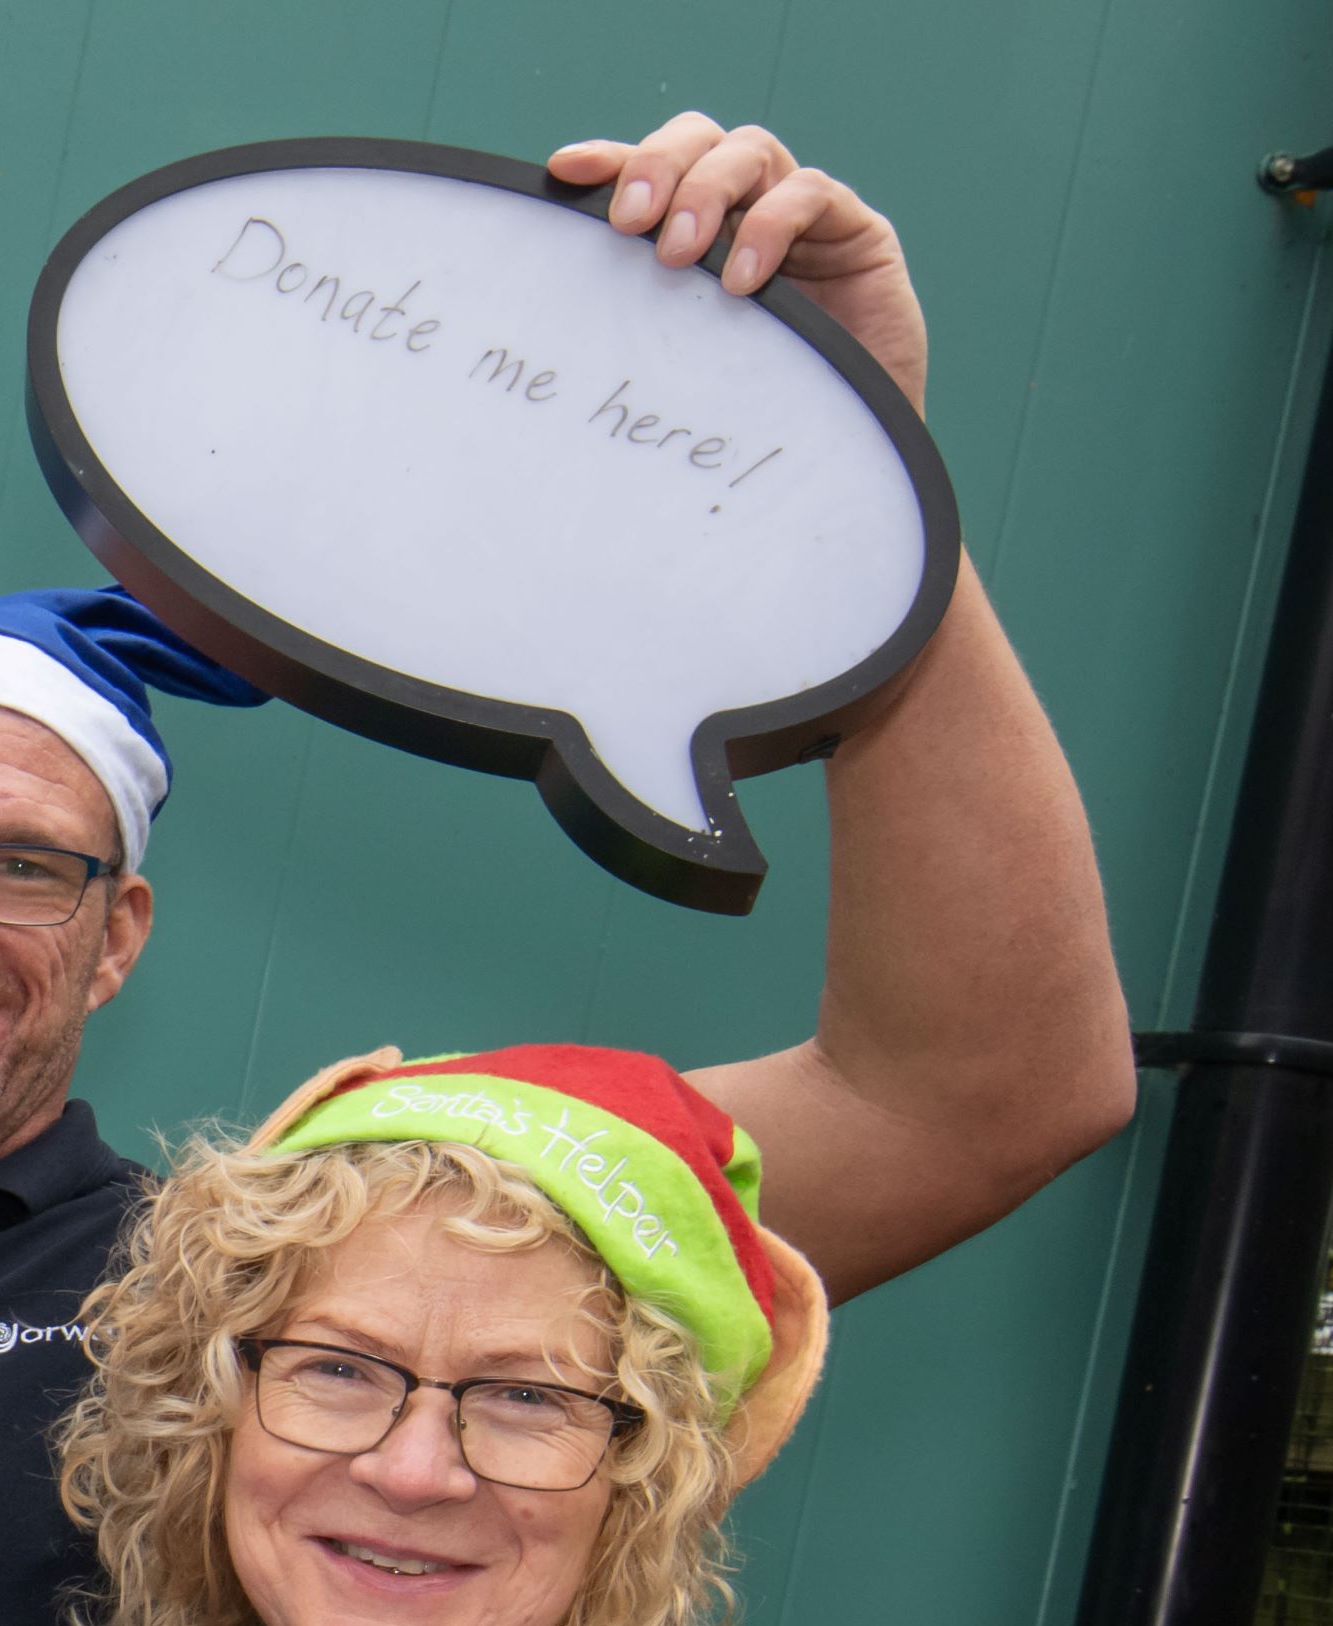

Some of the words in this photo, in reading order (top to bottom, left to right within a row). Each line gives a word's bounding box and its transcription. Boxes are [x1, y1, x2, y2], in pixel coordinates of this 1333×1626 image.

[210, 216, 441, 353] Donate
[468, 348, 557, 401] me
[588, 379, 783, 514] here!
[370, 1084, 533, 1137] Santa's
[539, 1107, 679, 1261] Helper
